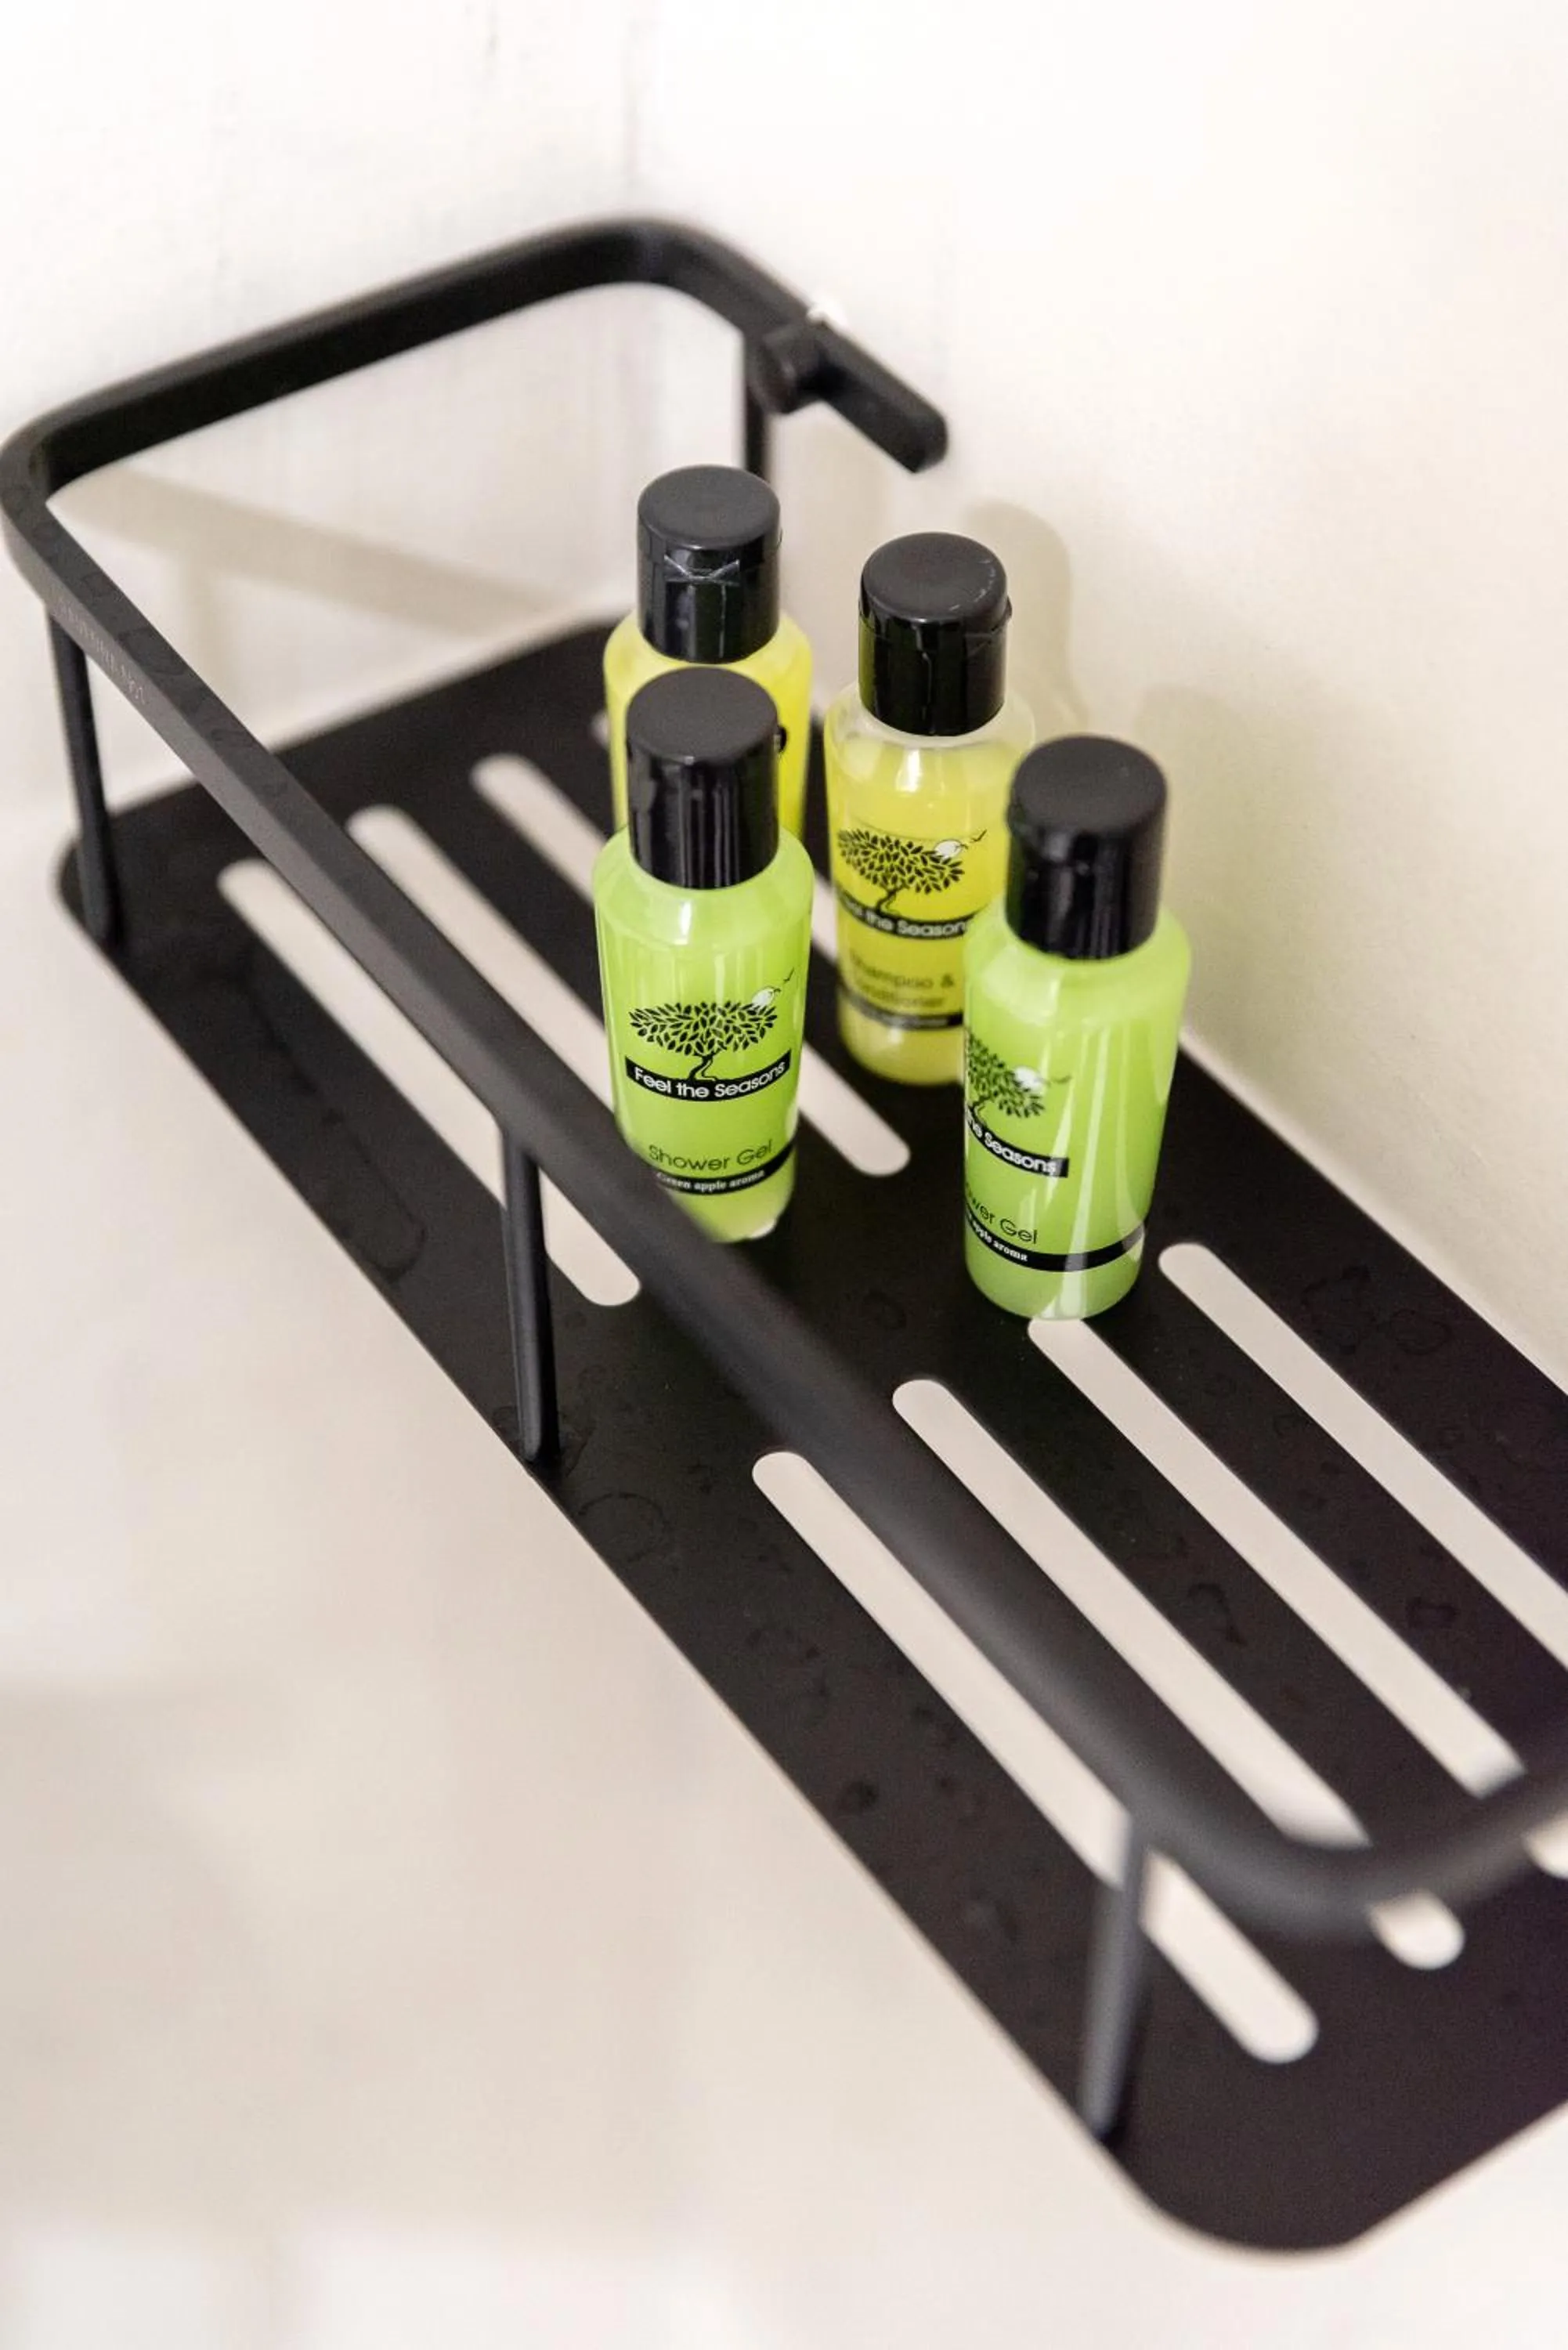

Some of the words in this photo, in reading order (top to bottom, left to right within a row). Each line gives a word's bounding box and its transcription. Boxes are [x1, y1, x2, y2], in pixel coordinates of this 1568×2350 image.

[896, 919, 967, 937] Season
[633, 1066, 672, 1094] Feel
[676, 1081, 710, 1098] the
[714, 1061, 786, 1098] Seasons
[649, 1144, 730, 1172] Shower
[736, 1139, 773, 1166] Gel
[985, 1132, 1057, 1174] Seasons
[695, 1178, 728, 1193] apple
[729, 1170, 765, 1188] aroma
[999, 1217, 1039, 1245] Gel
[993, 1240, 1028, 1262] aroma
